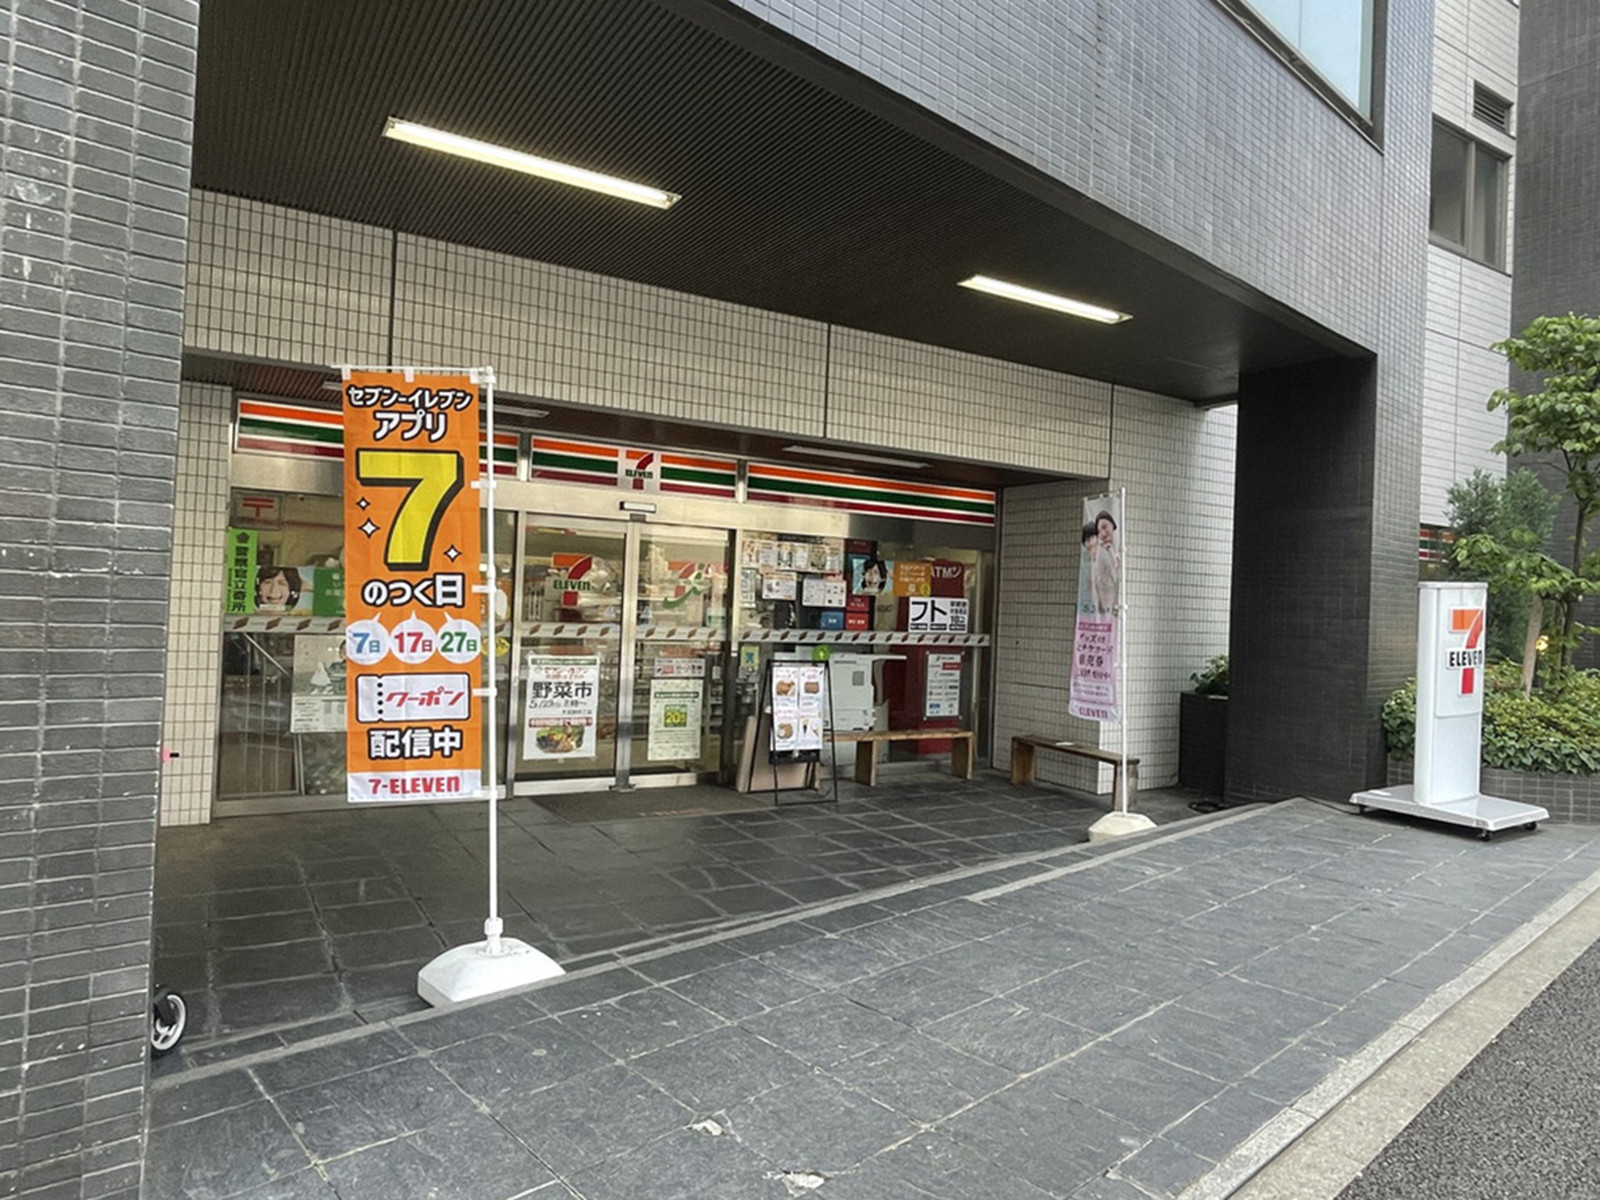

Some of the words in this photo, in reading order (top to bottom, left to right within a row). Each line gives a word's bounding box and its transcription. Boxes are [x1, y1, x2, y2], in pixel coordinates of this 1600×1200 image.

[374, 409, 446, 441] アプリ
[357, 449, 464, 570] 7
[362, 573, 465, 607] のつく日
[352, 632, 381, 654] 7日
[394, 632, 433, 653] 17日
[440, 632, 478, 652] 27日
[385, 686, 465, 708] クーポン
[532, 681, 593, 699] 野菜市
[368, 726, 463, 759] 配信中
